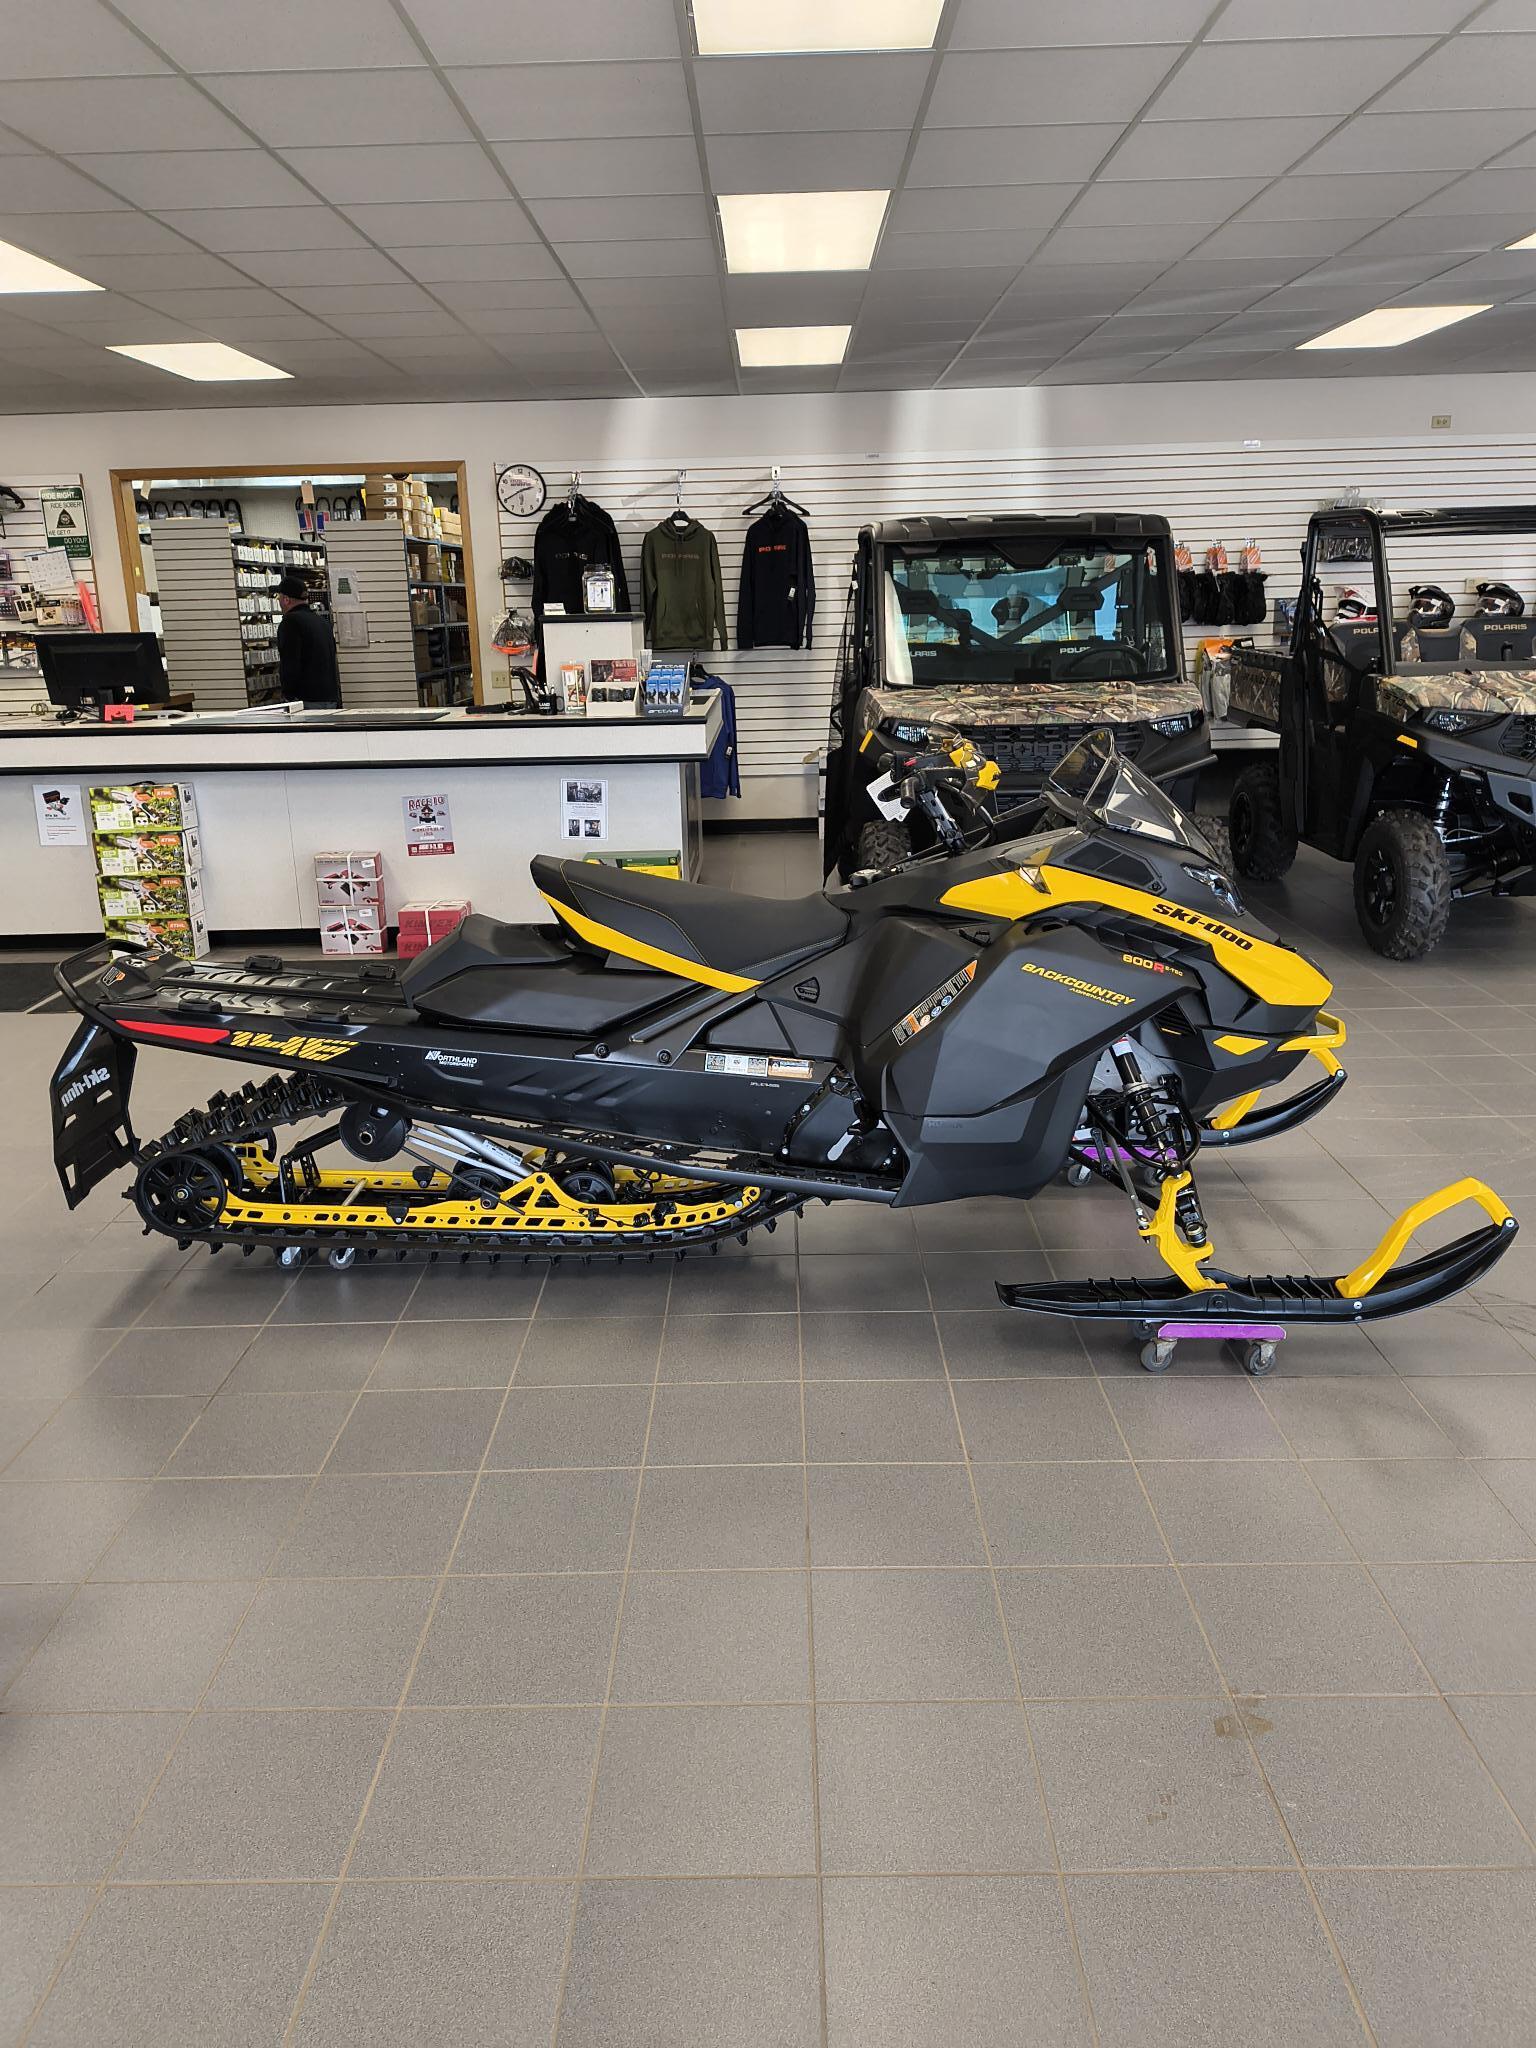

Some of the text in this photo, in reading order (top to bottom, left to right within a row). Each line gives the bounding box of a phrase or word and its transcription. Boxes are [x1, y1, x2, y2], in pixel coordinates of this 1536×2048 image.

[41, 492, 56, 500] RIDE
[1353, 627, 1397, 635] POLAS
[1483, 623, 1528, 631] POLARIS
[1152, 903, 1254, 951] ski-doo
[1122, 954, 1165, 974] 800R
[1021, 963, 1136, 1006] BACKCOUNTRY
[1069, 987, 1120, 1007] ADRENALINE
[425, 1050, 478, 1064] NORTHLAND
